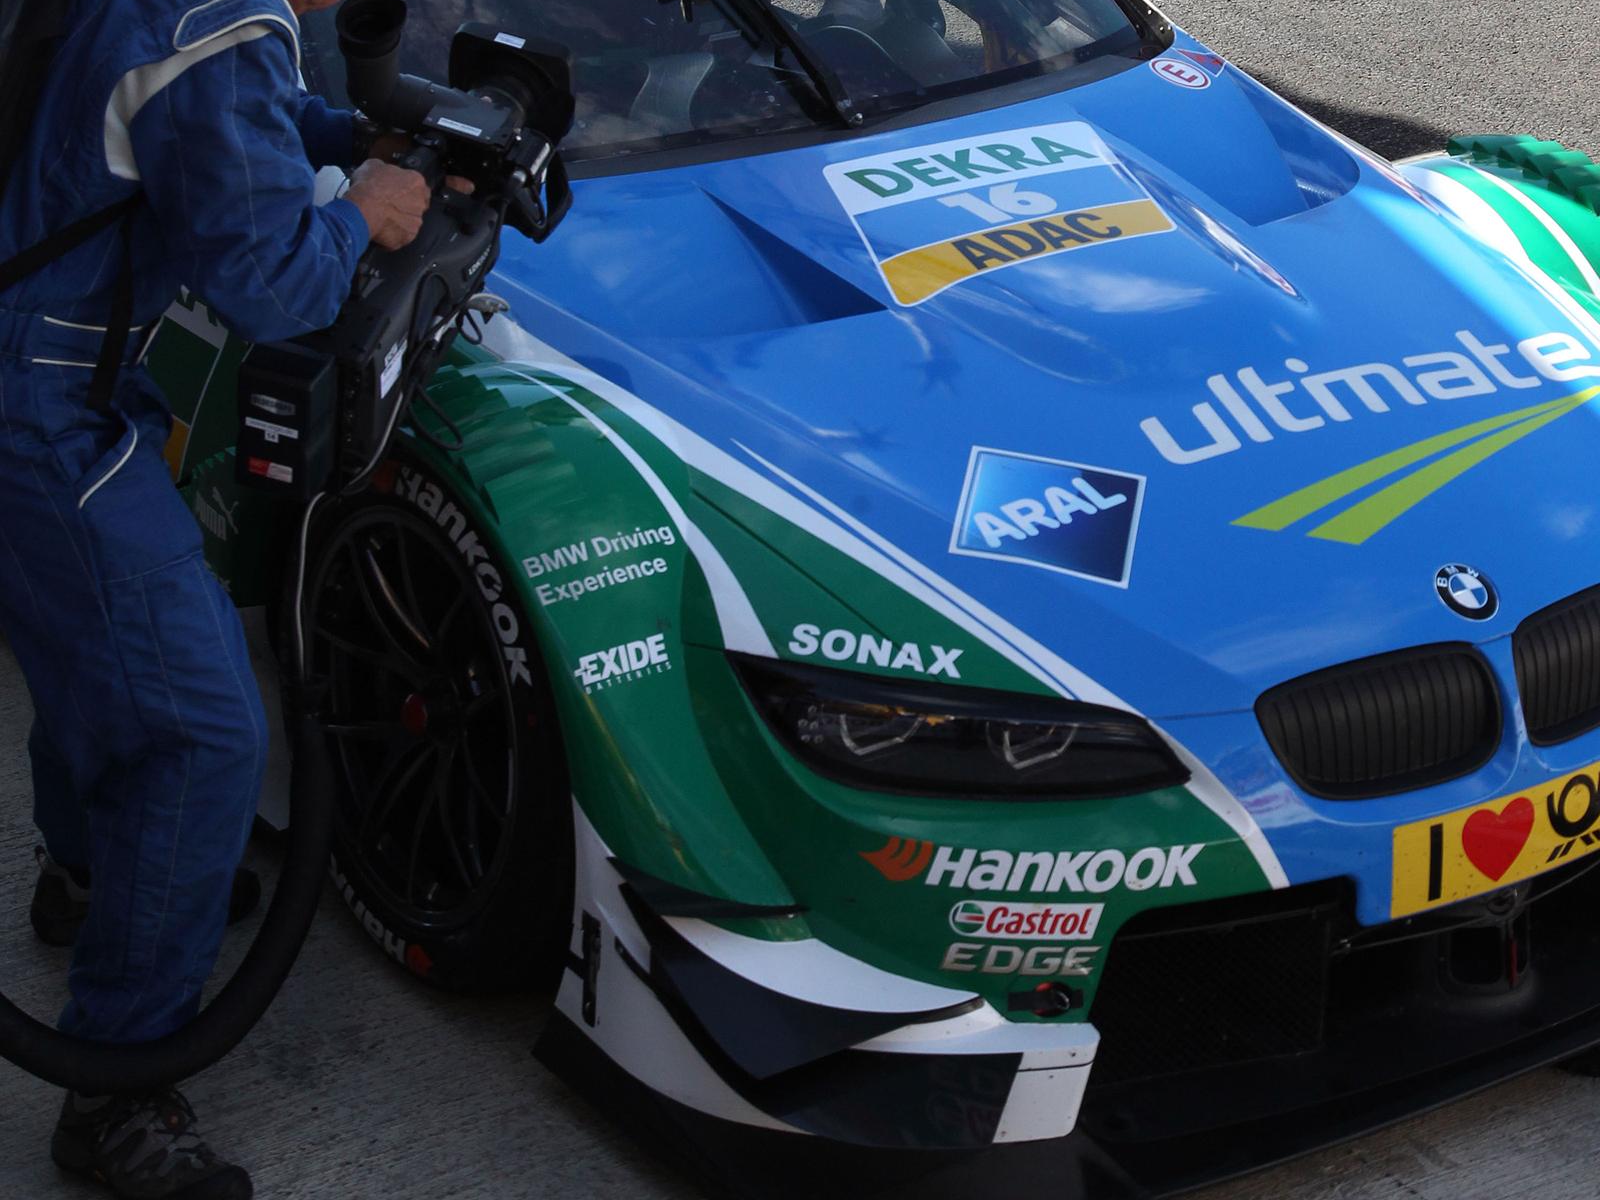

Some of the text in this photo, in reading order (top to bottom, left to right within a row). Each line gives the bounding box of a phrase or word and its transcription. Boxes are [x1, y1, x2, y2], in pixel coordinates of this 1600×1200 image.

[843, 136, 1097, 198] DEKRA
[934, 181, 1058, 223] 16
[950, 212, 1123, 270] ADAC
[1139, 329, 1600, 465] ultimate
[973, 476, 1127, 548] ARAL
[521, 524, 676, 579] BMW Driving
[534, 557, 669, 608] Experience
[574, 633, 668, 687] EXIDE
[788, 623, 964, 679] SONAX
[984, 906, 1090, 937] Castrol
[940, 944, 1101, 975] EDGE
